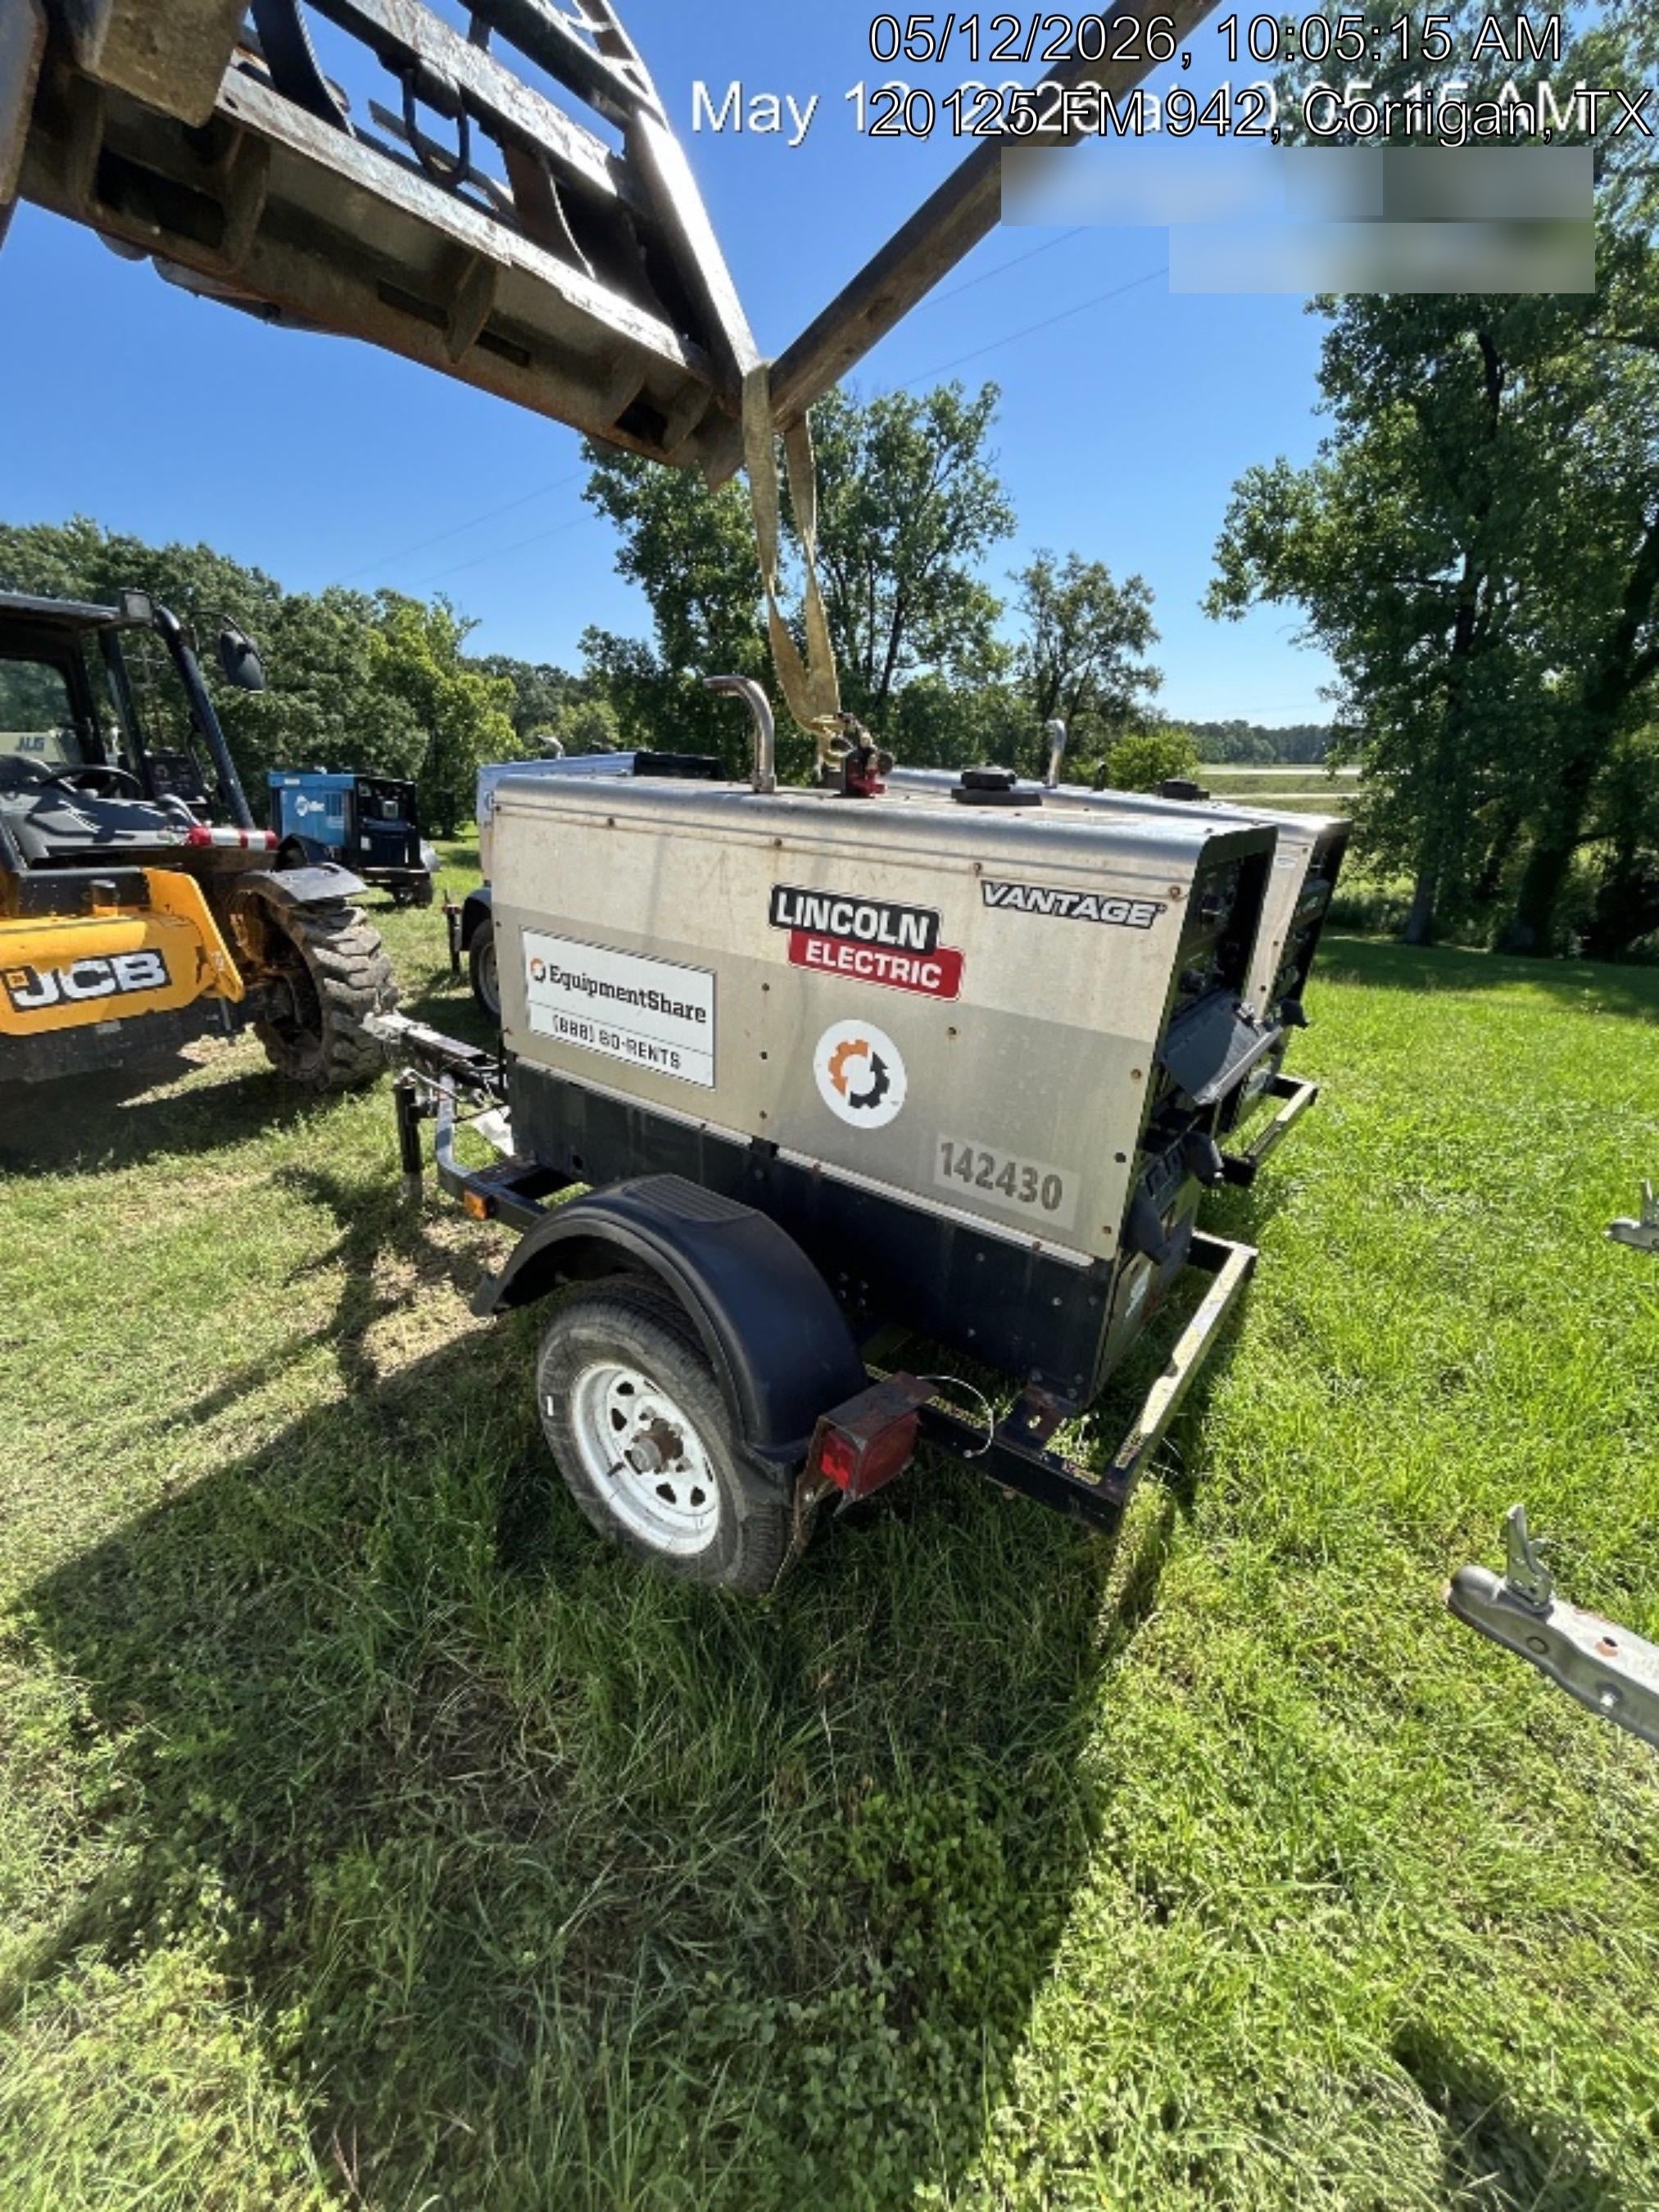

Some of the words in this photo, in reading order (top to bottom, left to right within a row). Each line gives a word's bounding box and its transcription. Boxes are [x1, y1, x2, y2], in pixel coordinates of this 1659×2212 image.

[775, 891, 930, 950] LINCOLN
[12, 952, 166, 1007] JCB
[805, 938, 942, 989] ELECTRIC
[550, 963, 707, 1023] EquipmentShare
[553, 1014, 595, 1043] (888)
[941, 1142, 1063, 1211] 142430
